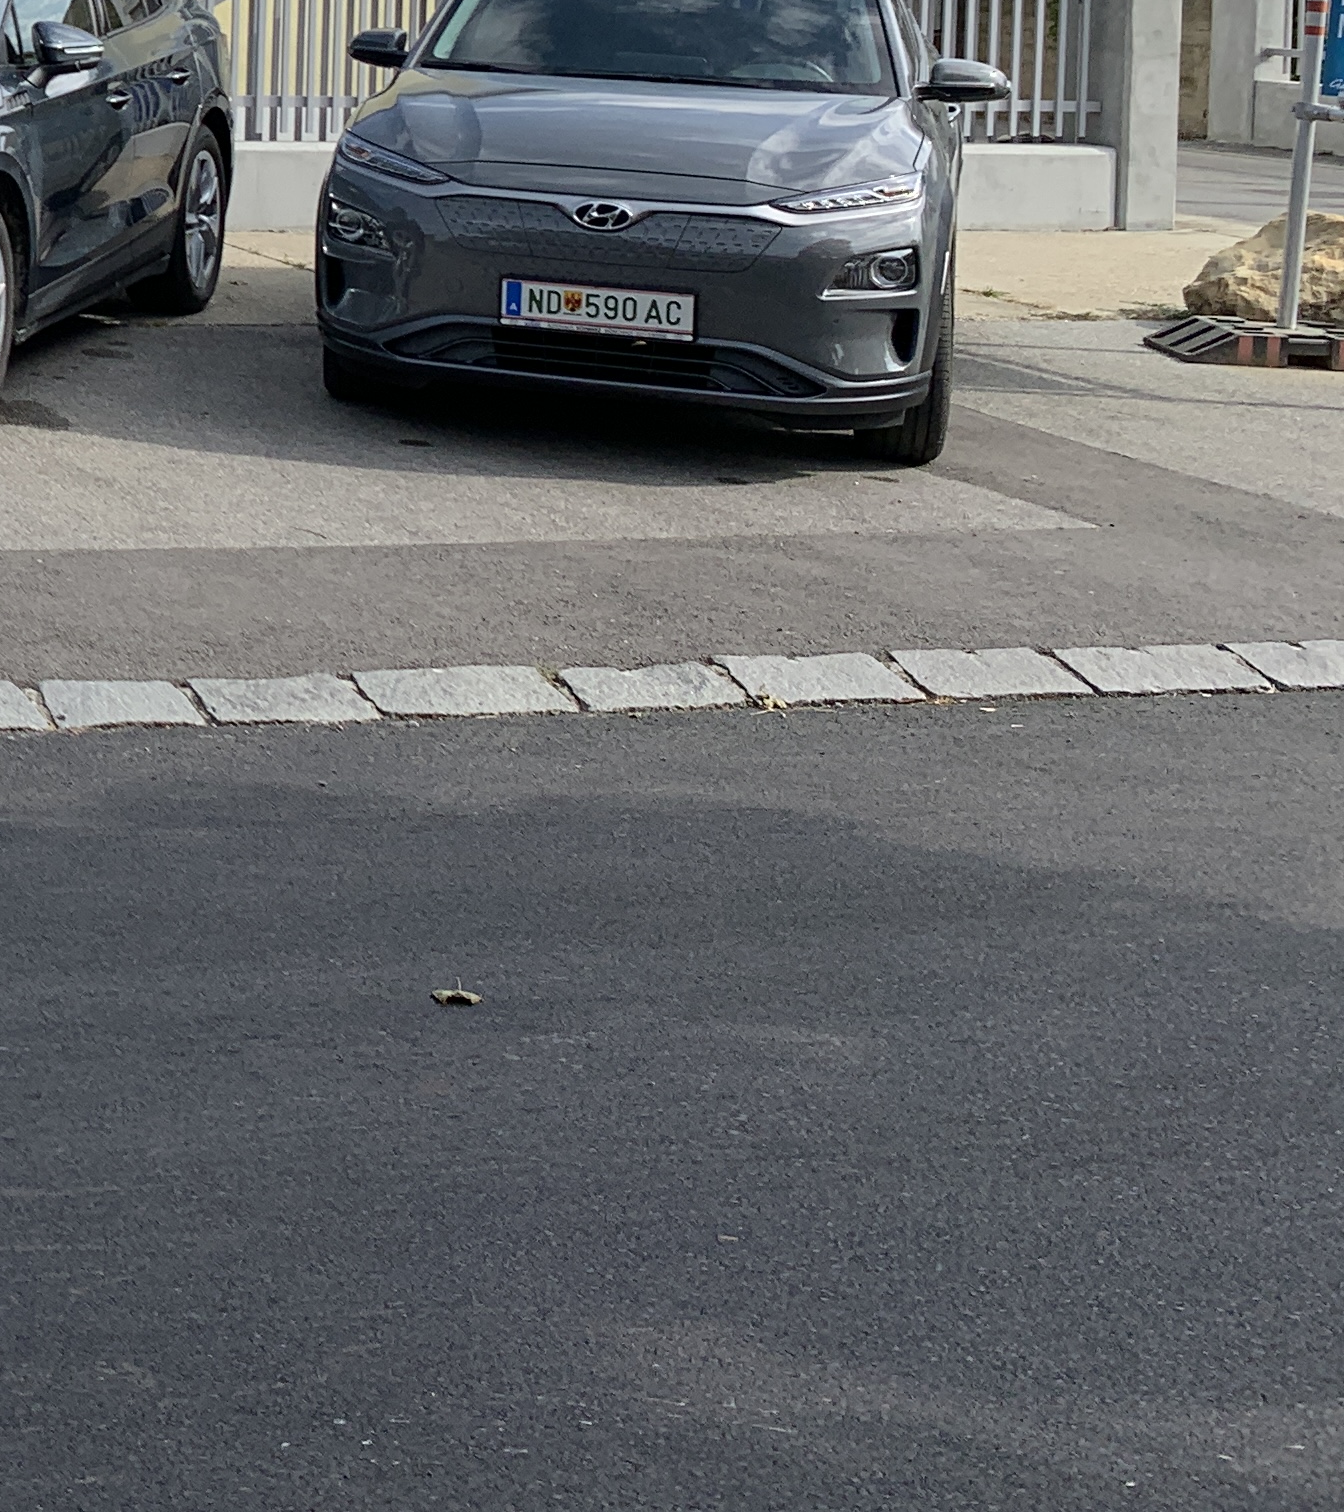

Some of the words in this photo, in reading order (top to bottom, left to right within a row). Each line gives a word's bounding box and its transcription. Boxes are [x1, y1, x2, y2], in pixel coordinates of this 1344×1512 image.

[528, 288, 561, 314] ND
[585, 294, 637, 321] 590
[644, 299, 682, 325] AC
